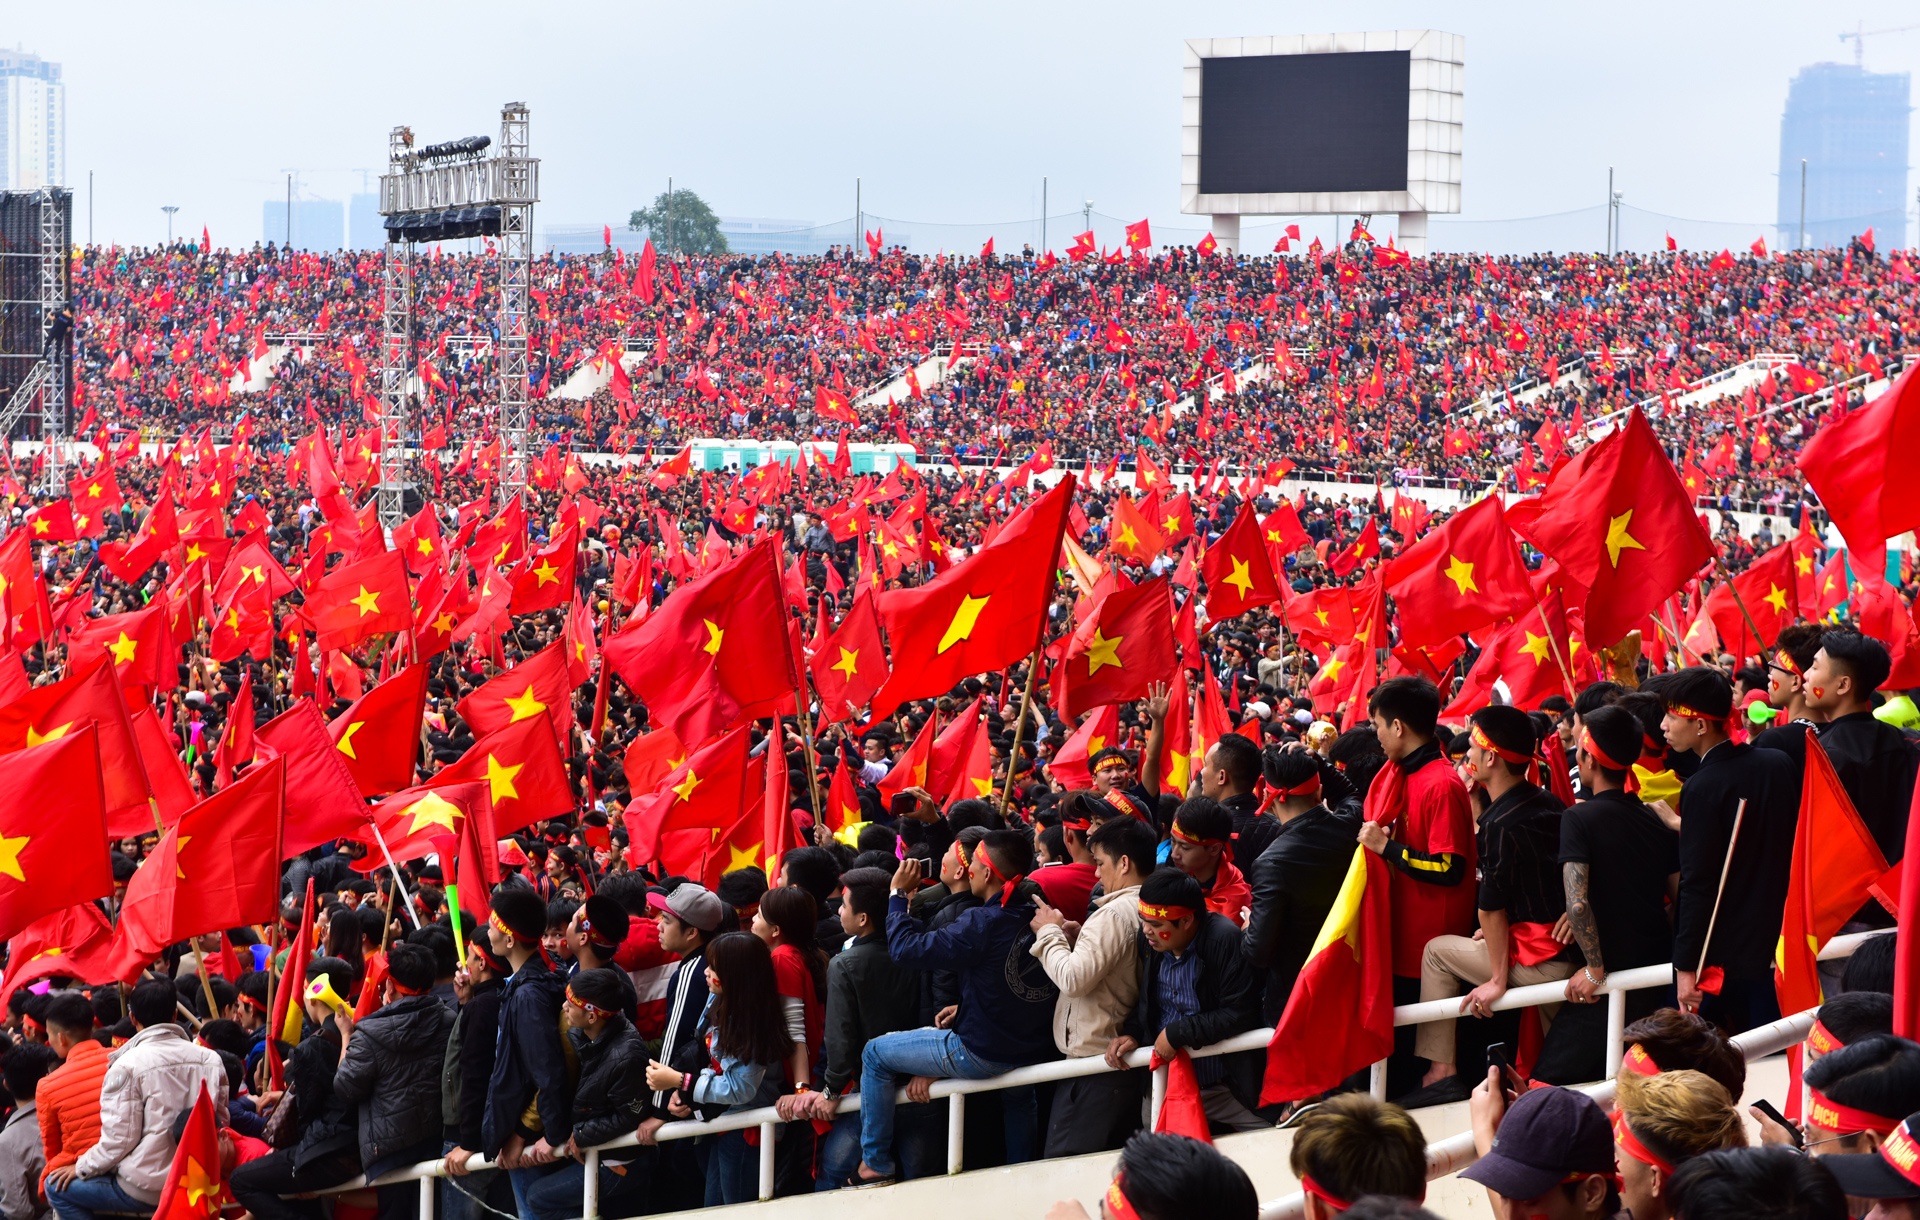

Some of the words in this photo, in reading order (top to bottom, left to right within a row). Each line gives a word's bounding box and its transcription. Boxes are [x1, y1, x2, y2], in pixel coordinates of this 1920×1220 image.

[1116, 799, 1133, 816] ĐỊCH
[1025, 986, 1051, 999] BENZ
[1811, 1029, 1832, 1053] ĐỊCH
[1813, 1103, 1840, 1129] ĐỊCH
[1886, 1134, 1918, 1172] THẮNG
